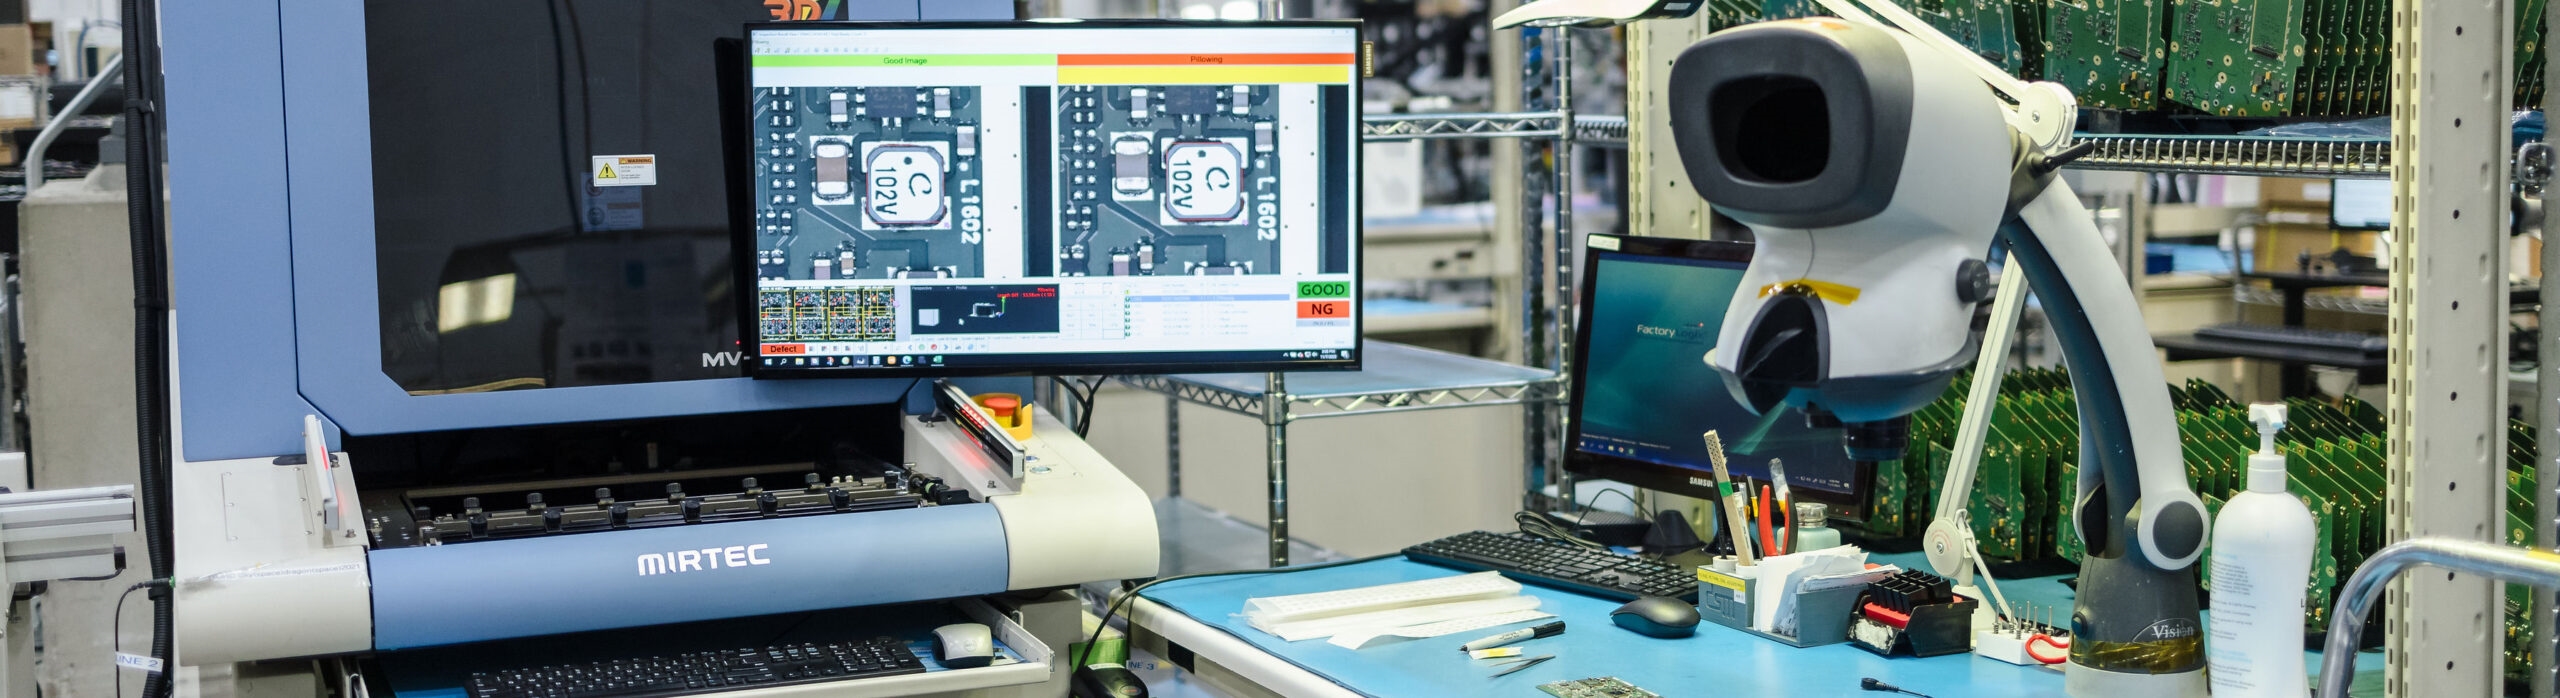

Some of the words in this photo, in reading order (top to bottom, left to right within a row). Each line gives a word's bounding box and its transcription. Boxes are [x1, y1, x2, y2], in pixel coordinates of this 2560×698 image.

[883, 57, 903, 65] Good
[905, 57, 927, 66] Image
[1190, 55, 1223, 65] Pillowing
[909, 173, 932, 197] C
[1172, 160, 1193, 208] 102V
[1205, 167, 1230, 191] C
[875, 167, 898, 215] 102V
[961, 179, 981, 244] L1602
[1257, 176, 1277, 241] L1602
[1301, 284, 1345, 296] GOOD
[1311, 303, 1333, 315] NG
[770, 345, 797, 353] Defect
[1689, 476, 1714, 488] SAMSU
[637, 543, 771, 576] MIRTEC
[2152, 624, 2194, 639] Vision
[117, 655, 142, 666] INE
[148, 659, 159, 668] 2
[1128, 661, 1143, 669] INE
[1146, 663, 1154, 671] 3
